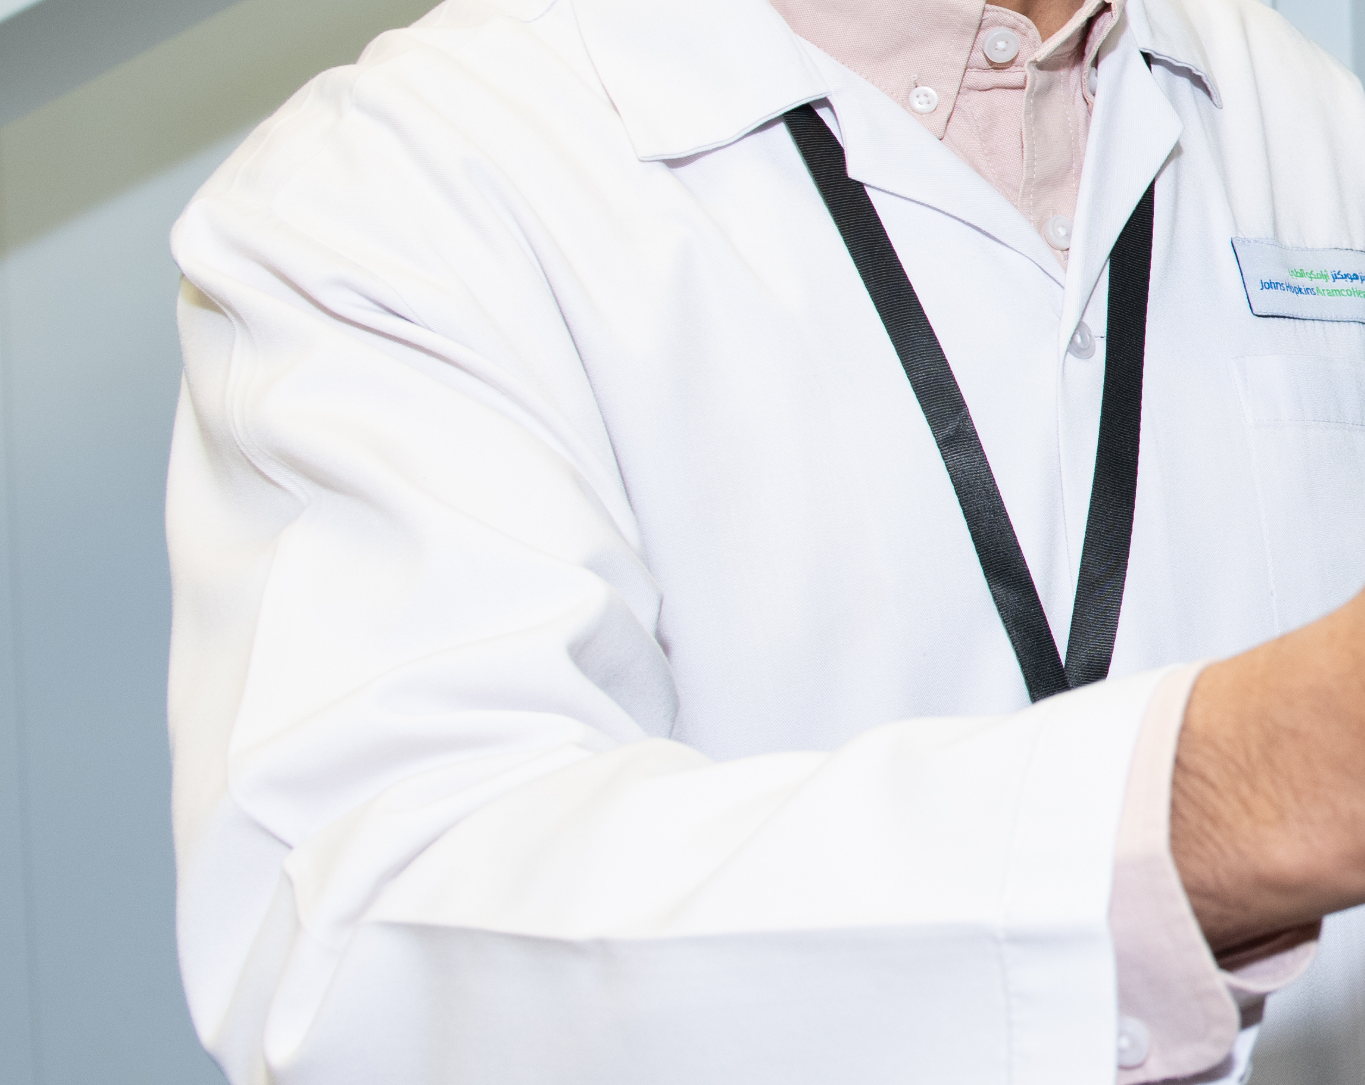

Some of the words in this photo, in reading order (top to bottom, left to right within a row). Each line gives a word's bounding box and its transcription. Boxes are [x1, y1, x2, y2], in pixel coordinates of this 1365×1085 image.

[1259, 279, 1285, 291] Johns
[1285, 281, 1316, 297] Hopkins
[1316, 286, 1351, 297] Aramco
